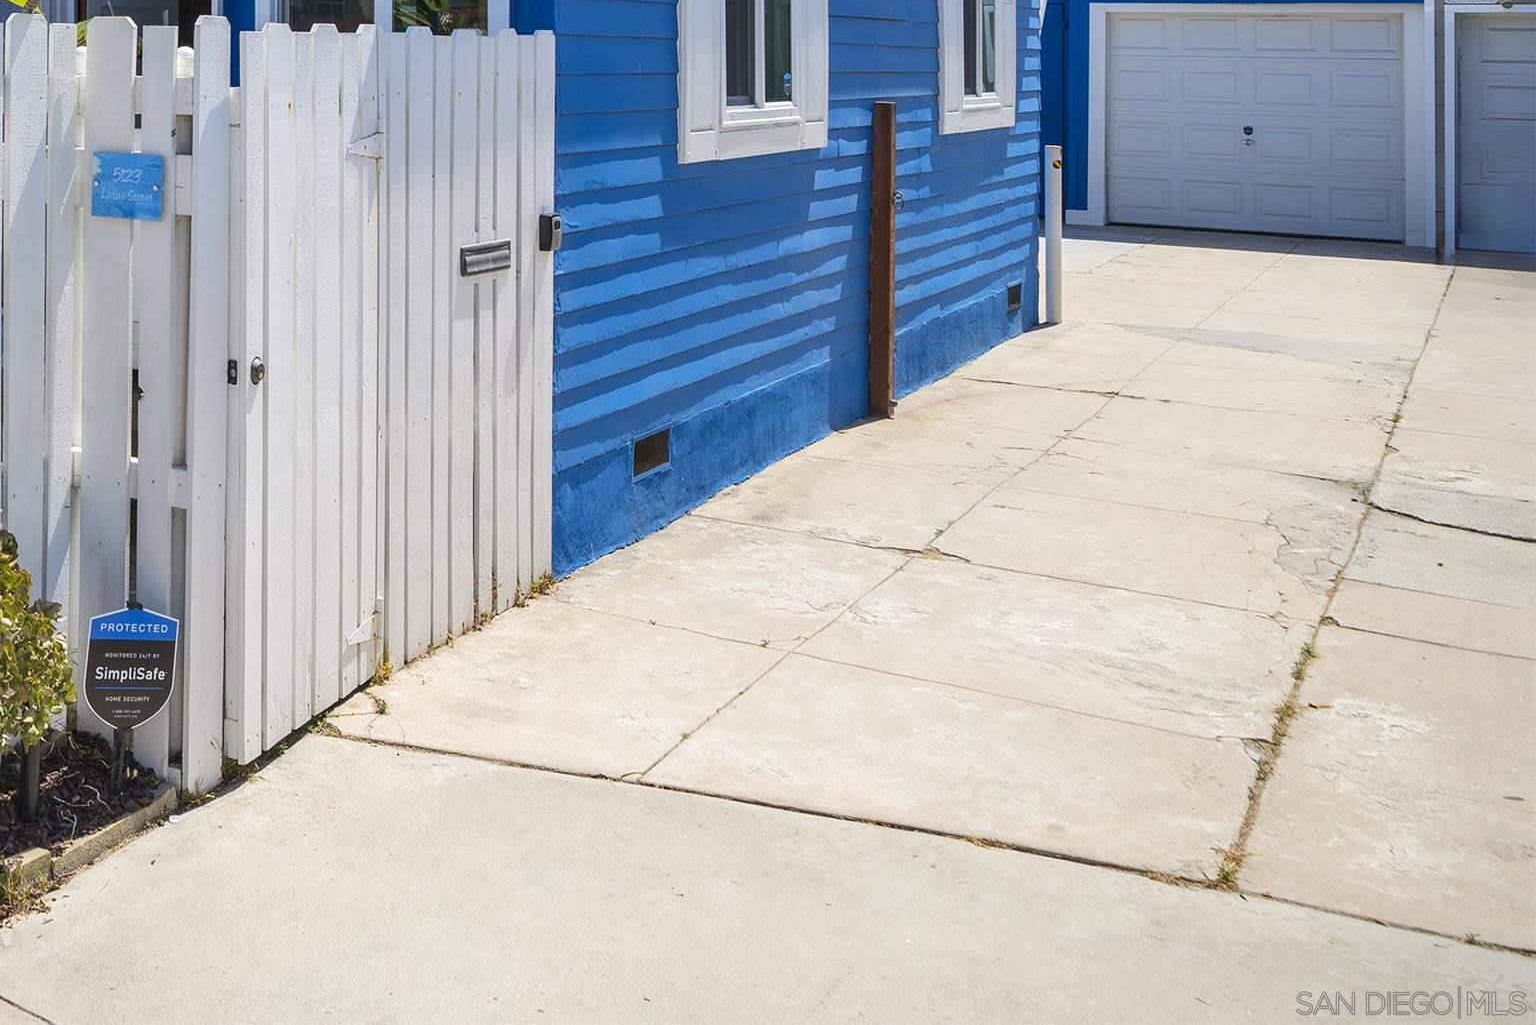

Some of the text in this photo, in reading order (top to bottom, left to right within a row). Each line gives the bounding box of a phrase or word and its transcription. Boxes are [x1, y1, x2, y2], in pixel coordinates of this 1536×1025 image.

[112, 167, 143, 184] 5123
[100, 623, 169, 634] PROTECTED
[95, 666, 166, 684] SimpliSafe
